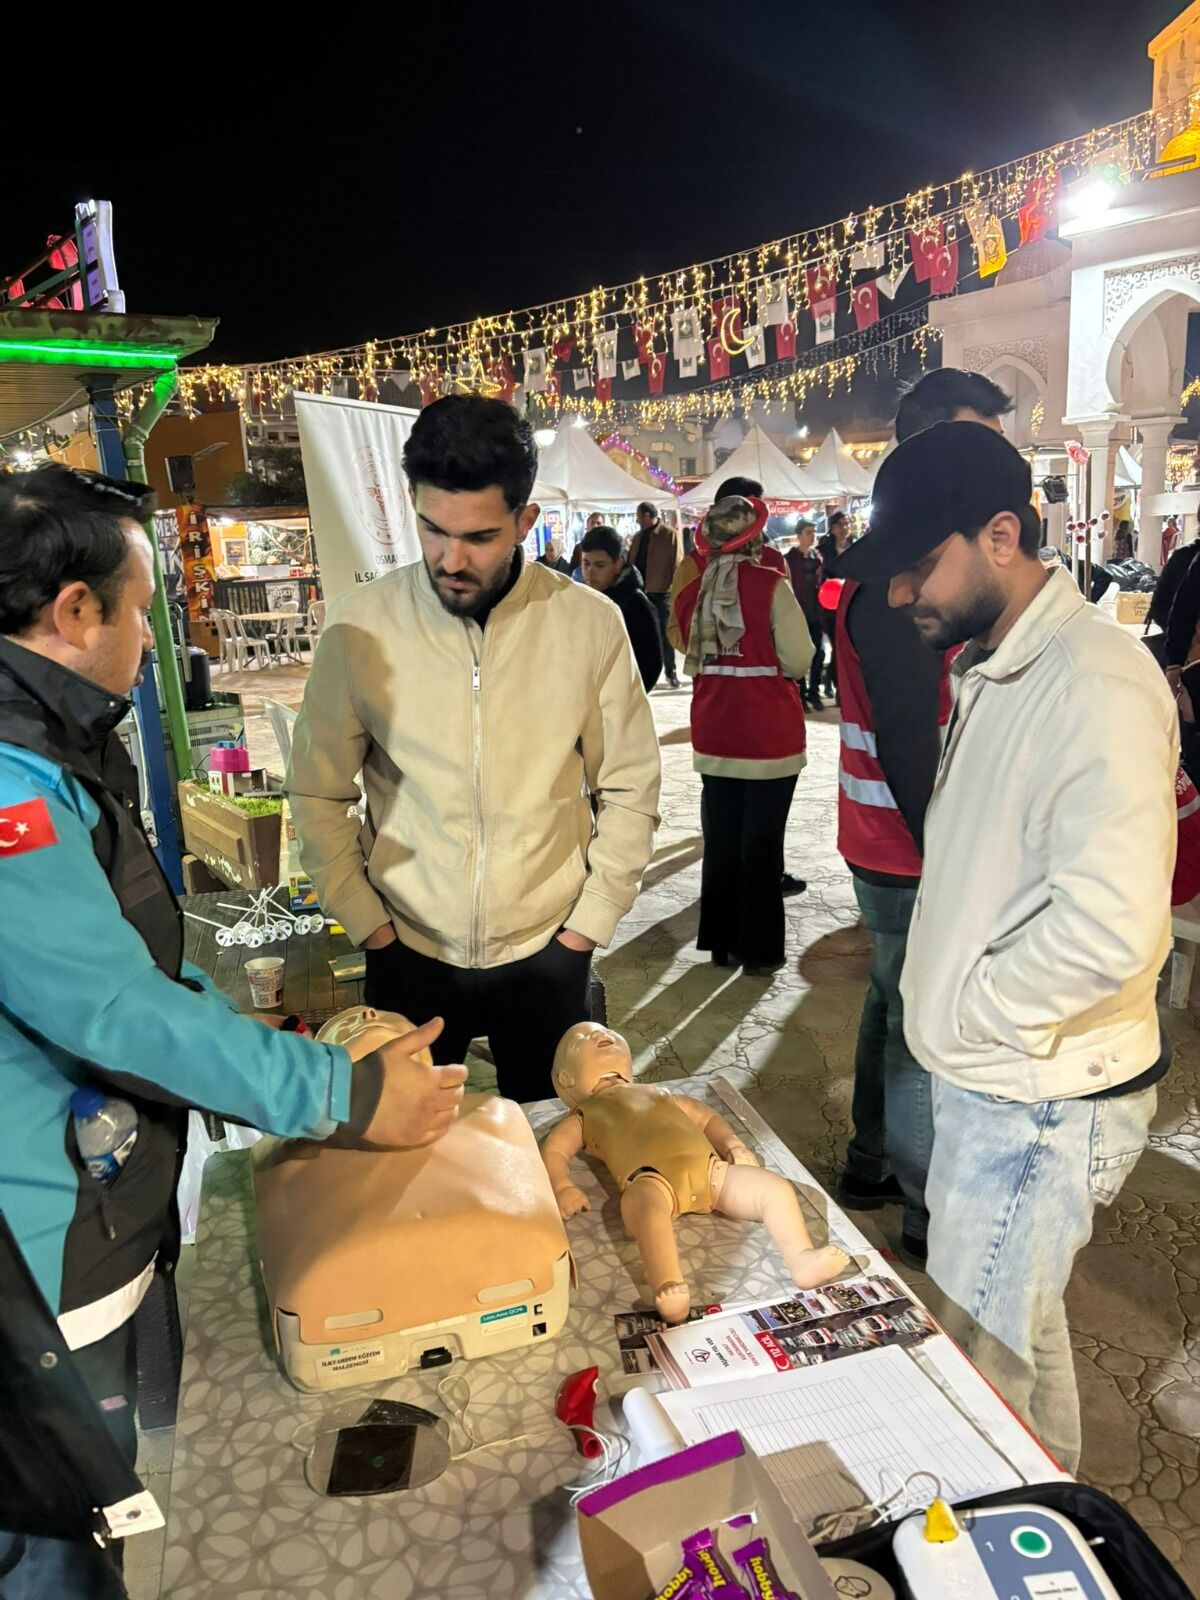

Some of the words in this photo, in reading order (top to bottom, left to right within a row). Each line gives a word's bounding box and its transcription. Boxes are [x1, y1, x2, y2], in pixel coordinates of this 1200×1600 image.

[354, 571, 364, 583] İL
[770, 1347, 782, 1358] 112
[985, 1541, 996, 1553] 1
[750, 1556, 775, 1600] hobby
